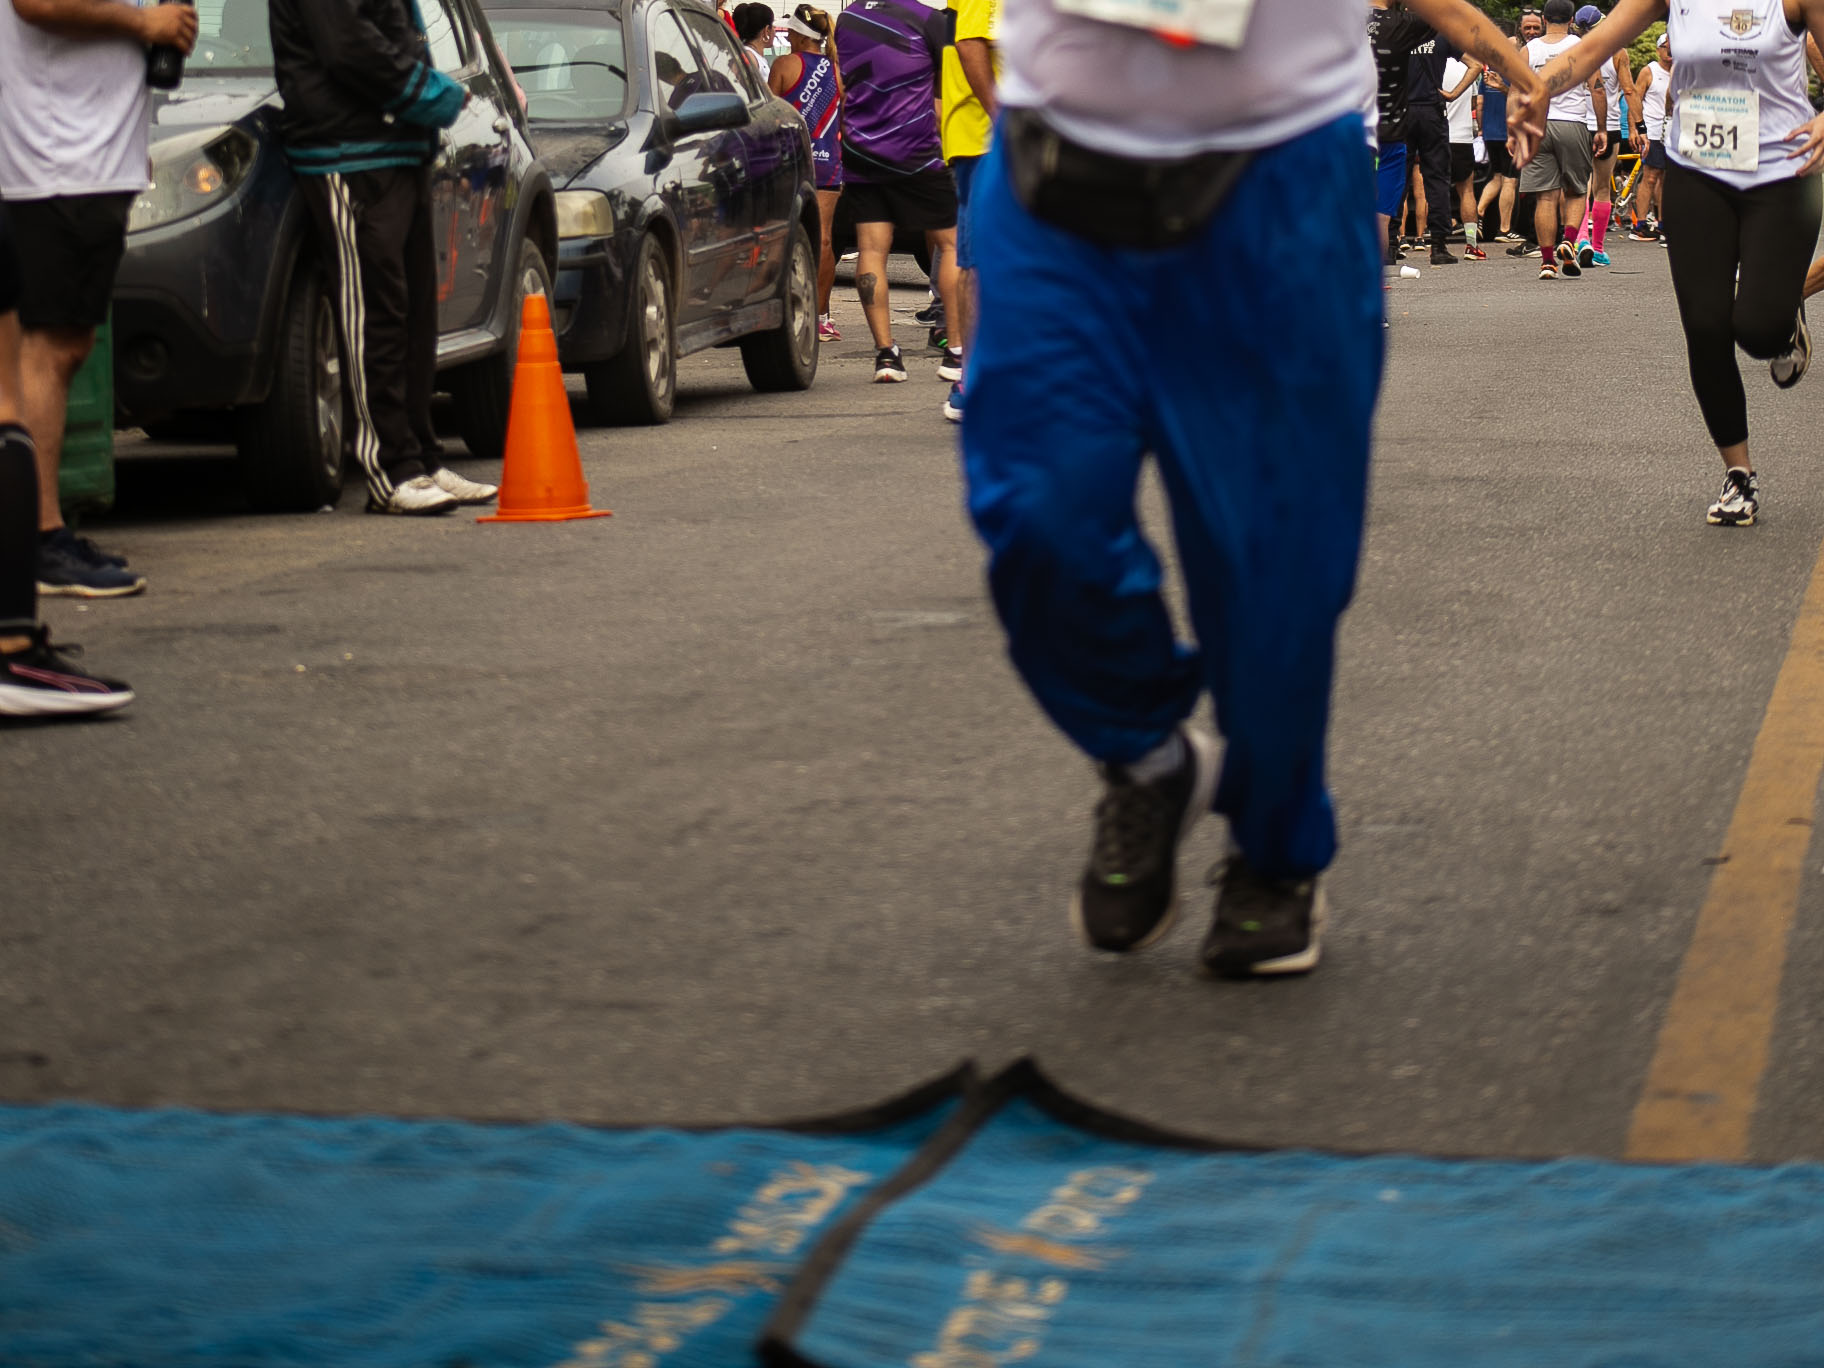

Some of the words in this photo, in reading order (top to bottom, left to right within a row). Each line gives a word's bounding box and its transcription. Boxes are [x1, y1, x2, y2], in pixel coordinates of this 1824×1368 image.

[799, 57, 831, 103] cronos
[1704, 94, 1746, 105] MARATON
[1694, 123, 1738, 151] 551
